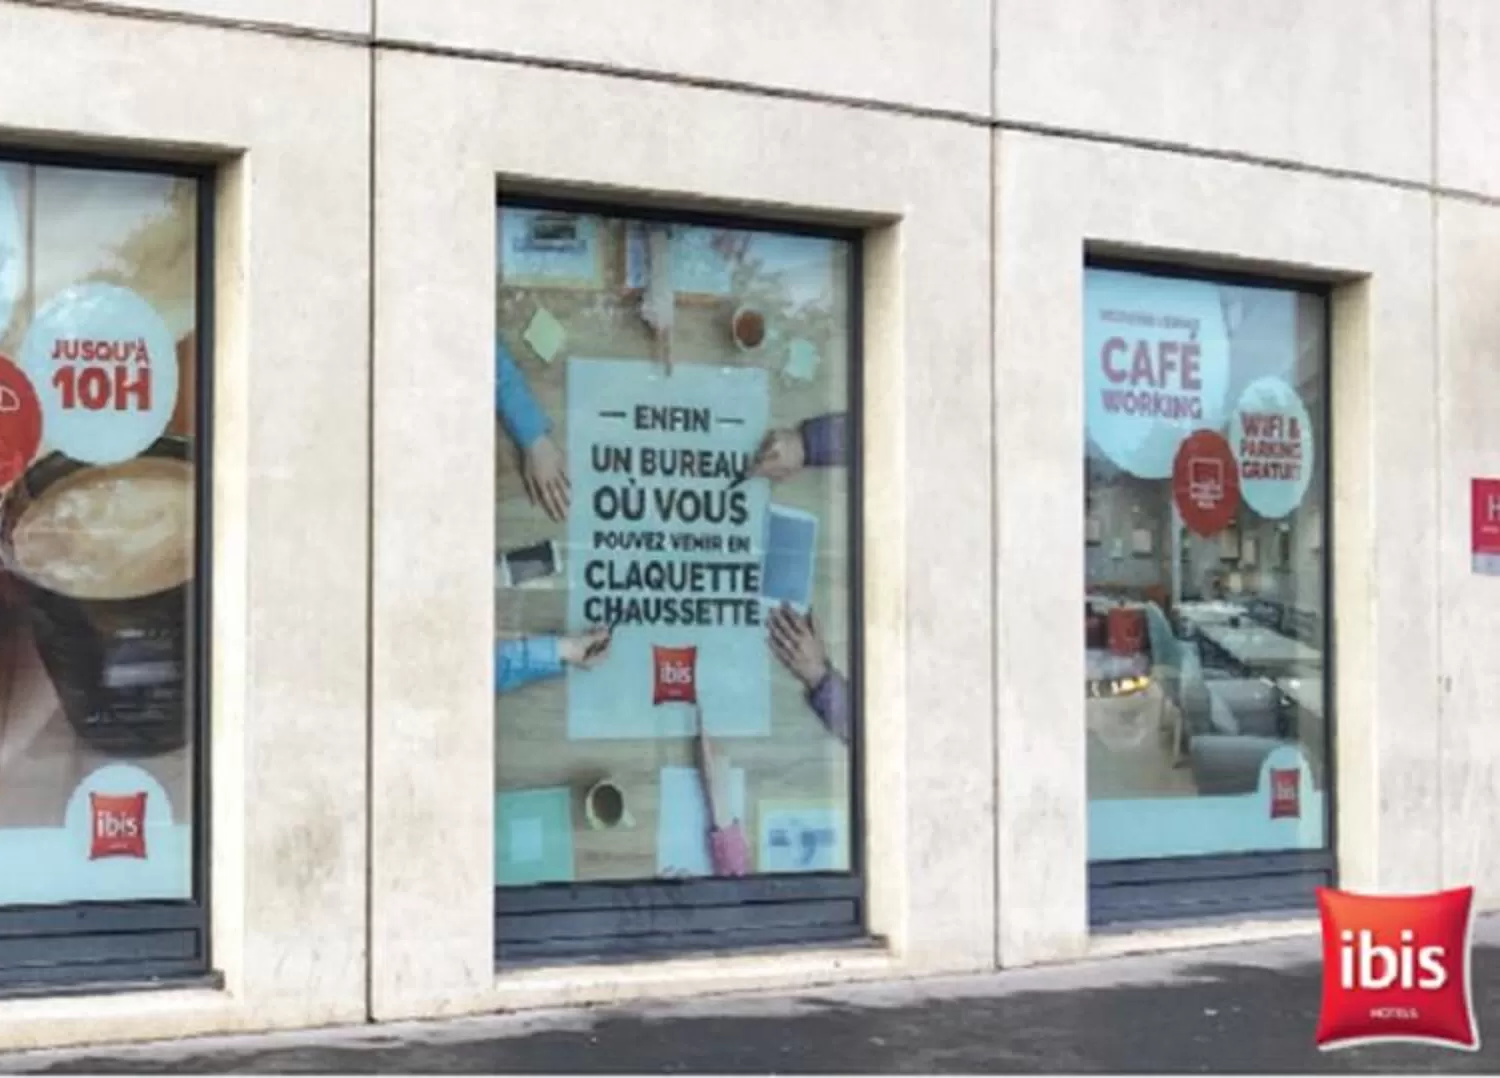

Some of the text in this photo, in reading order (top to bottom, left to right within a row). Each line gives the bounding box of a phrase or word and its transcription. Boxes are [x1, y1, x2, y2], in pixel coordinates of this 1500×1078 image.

[51, 338, 151, 364] JUSQU'À
[1101, 331, 1202, 390] CAFÉ
[51, 365, 152, 411] 10H
[634, 404, 711, 433] ENFIN
[1101, 388, 1203, 420] WORKING
[591, 444, 751, 481] UN BUREAU
[592, 477, 749, 526] OÙ VOUS
[593, 530, 751, 553] POUVEZ VENIR EN
[583, 560, 761, 593] CLAQUETTE
[583, 597, 761, 627] CHAUSSETTE
[660, 660, 693, 684] ibis
[97, 810, 139, 837] ibis
